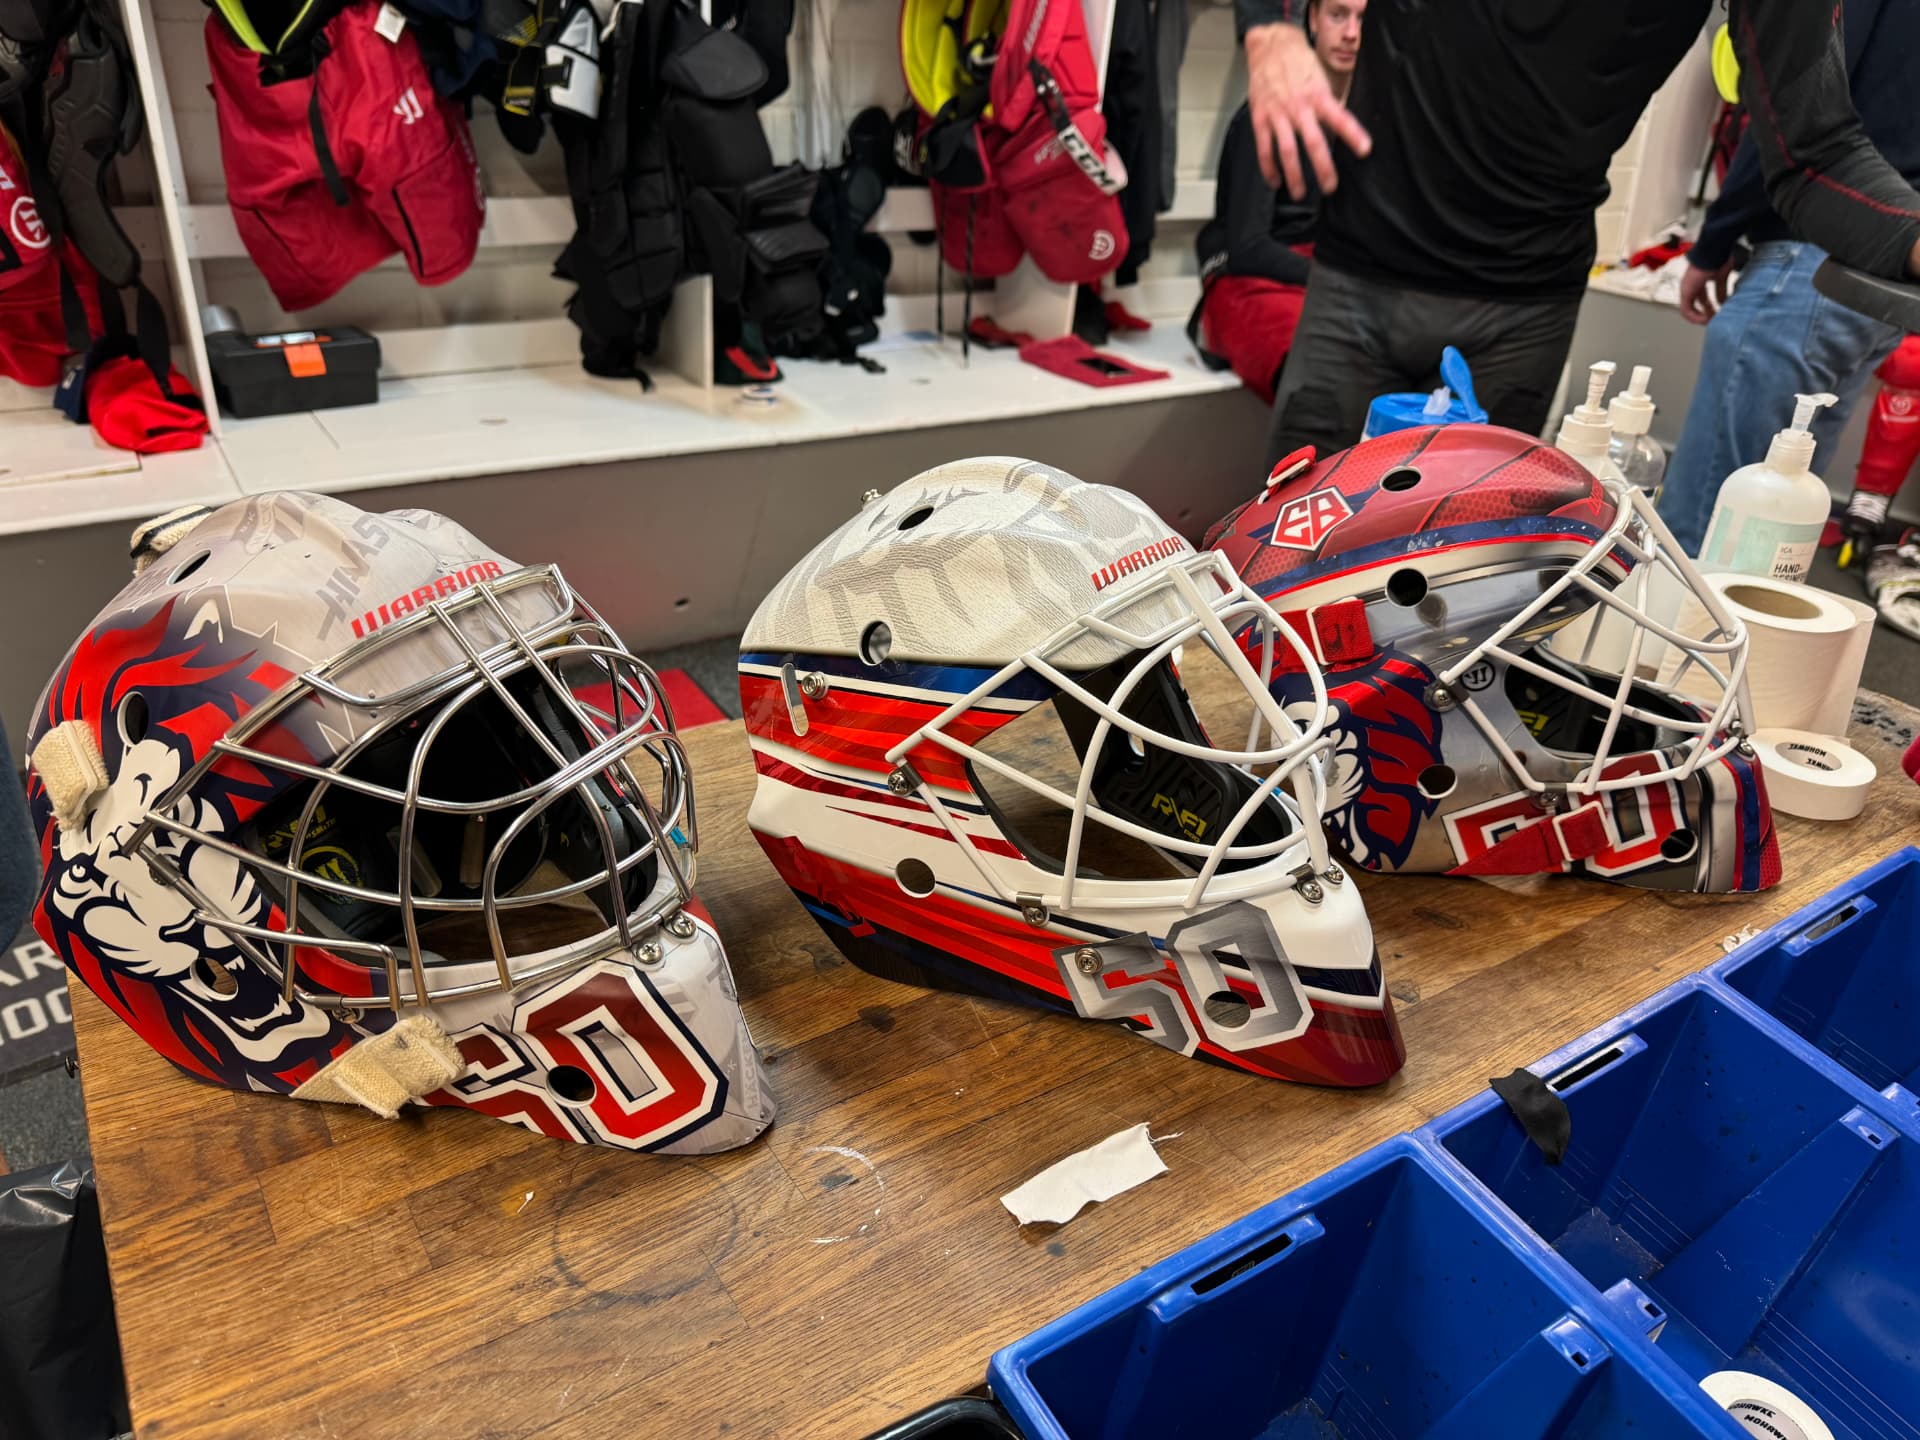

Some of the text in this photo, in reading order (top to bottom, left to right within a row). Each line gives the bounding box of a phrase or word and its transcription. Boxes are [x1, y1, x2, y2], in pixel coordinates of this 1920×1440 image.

[1063, 132, 1116, 187] CCM
[1091, 536, 1186, 592] WARRIOR
[351, 561, 503, 639] WARRIOR
[1052, 900, 1315, 1058] 50
